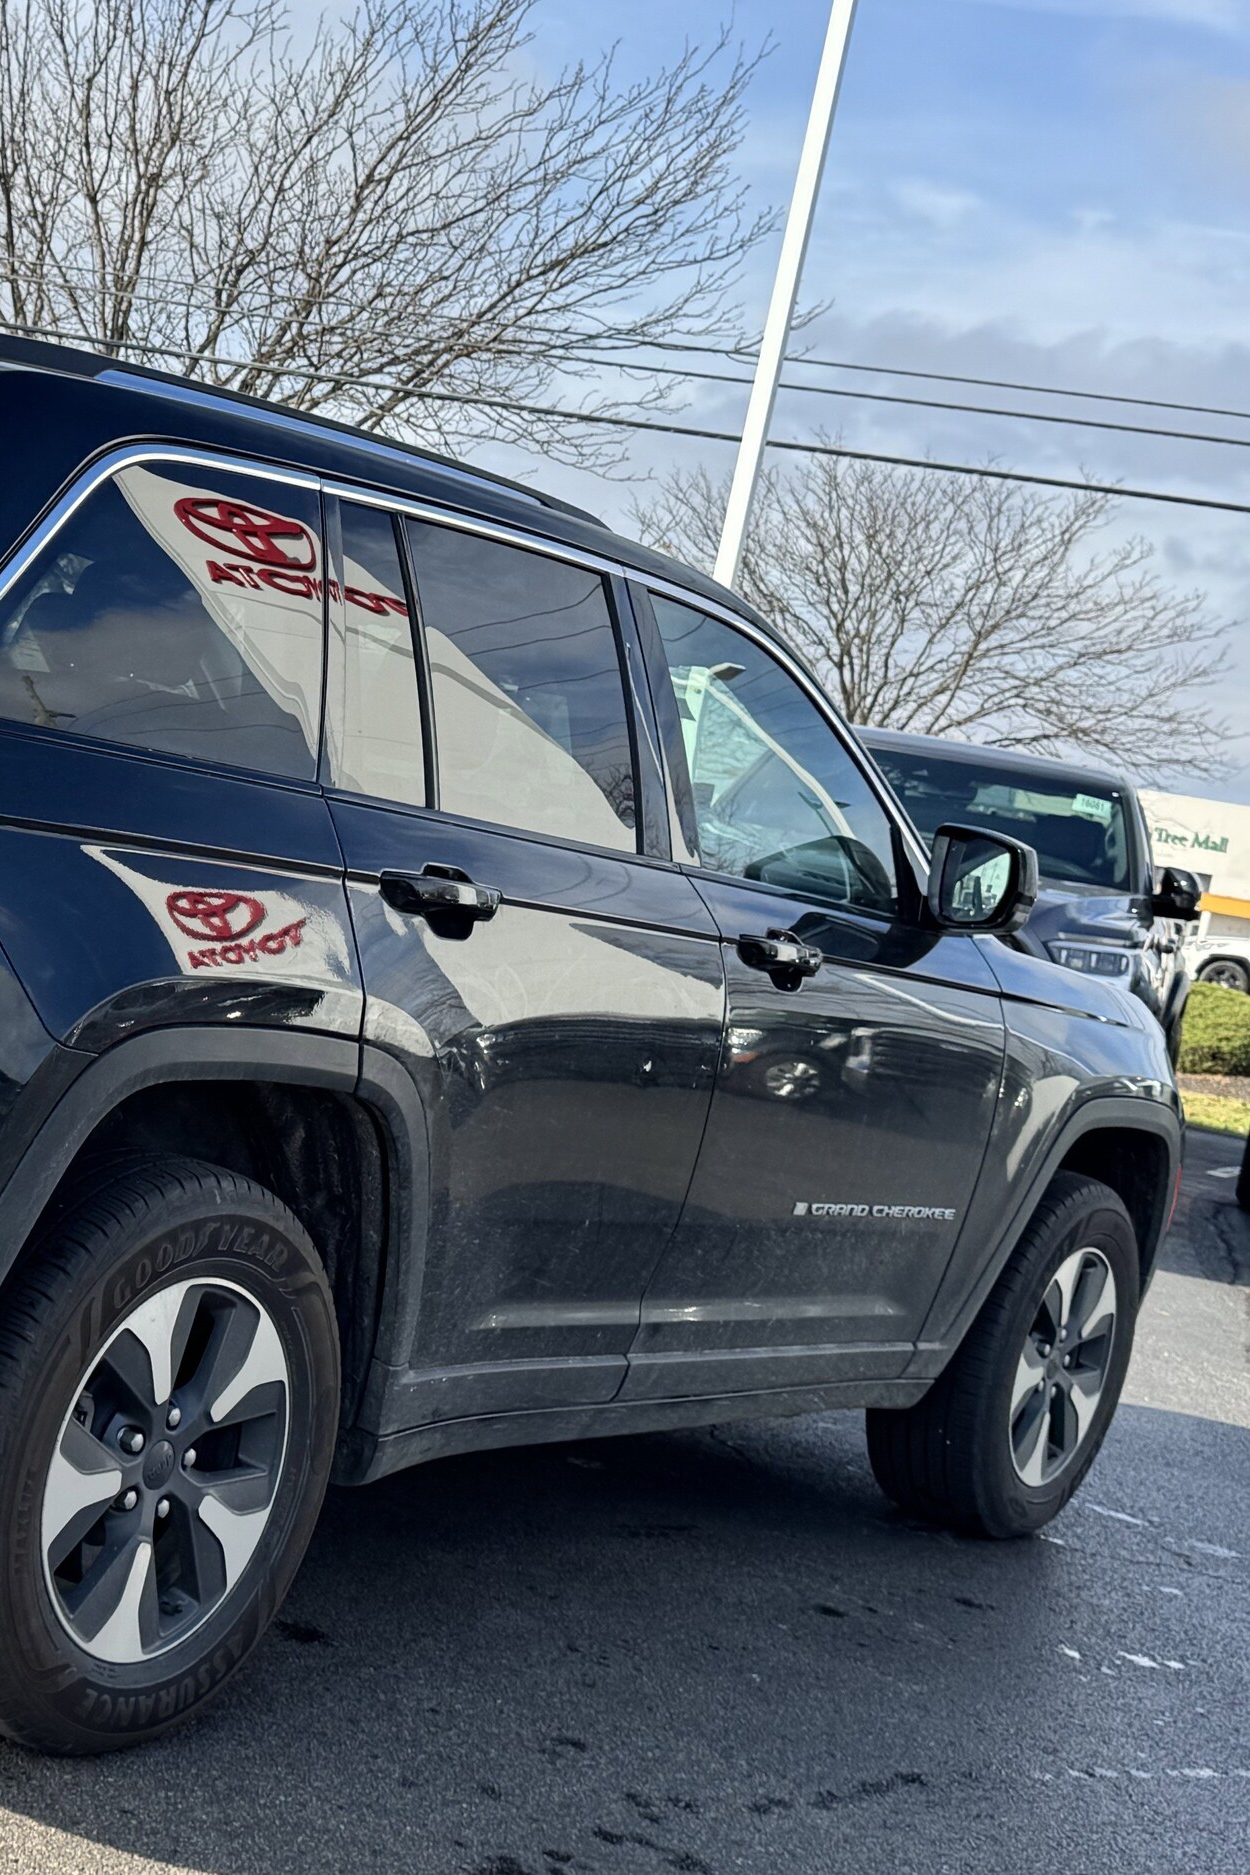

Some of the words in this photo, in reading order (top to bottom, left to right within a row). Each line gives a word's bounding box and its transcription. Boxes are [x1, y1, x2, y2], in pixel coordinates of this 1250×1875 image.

[1154, 827, 1189, 848] Tree
[1190, 832, 1229, 853] Mall
[811, 1203, 870, 1217] GRAND
[872, 1205, 956, 1220] CHEROKEE
[113, 1222, 289, 1309] GOODYEAR
